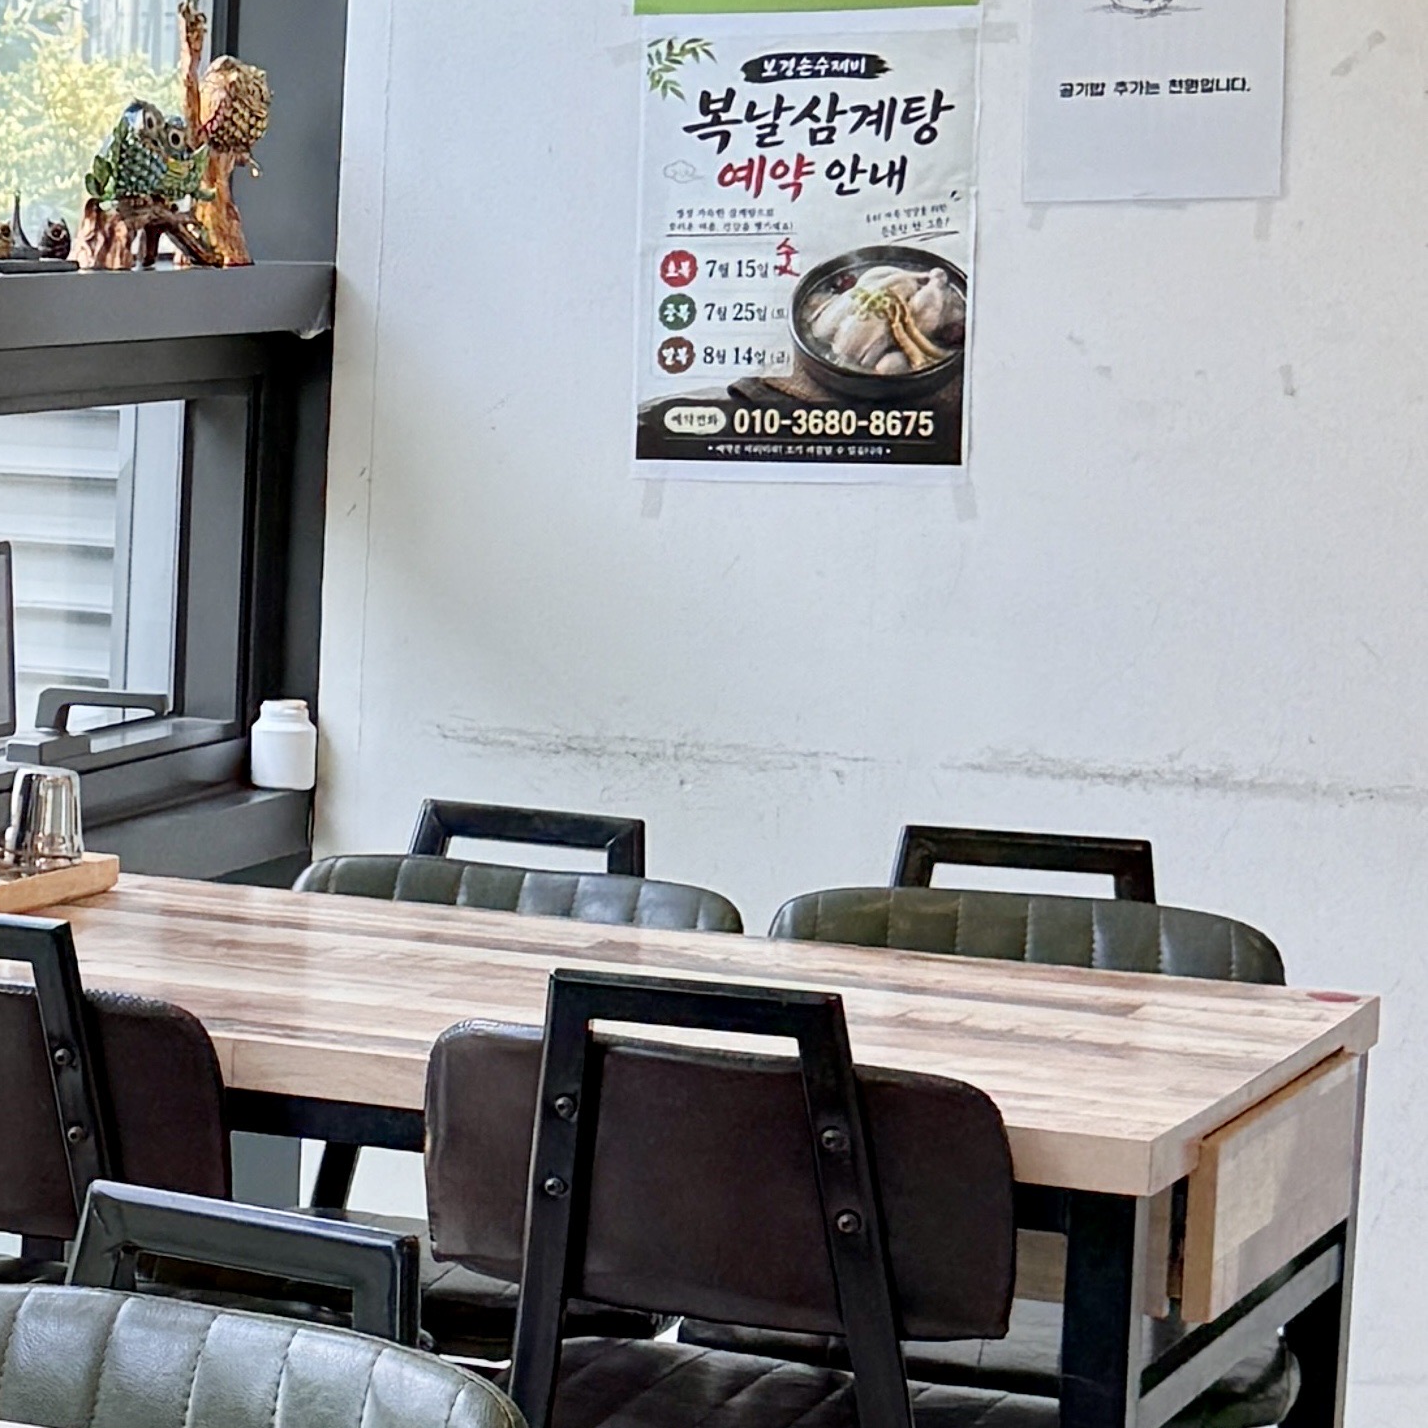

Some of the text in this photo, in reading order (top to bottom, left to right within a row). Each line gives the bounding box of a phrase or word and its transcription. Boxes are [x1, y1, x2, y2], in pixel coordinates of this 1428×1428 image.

[1059, 76, 1251, 98] 공기밥 추가는 천원입니다.
[682, 87, 955, 155] 복날삼계탕
[717, 152, 908, 202] 예약 안내
[706, 259, 769, 278] 7월 15일
[704, 303, 727, 321] 7월
[732, 303, 767, 322] 25일
[703, 346, 726, 365] 8월
[734, 346, 766, 365] 14일
[734, 408, 935, 436] 010-3680-8675
